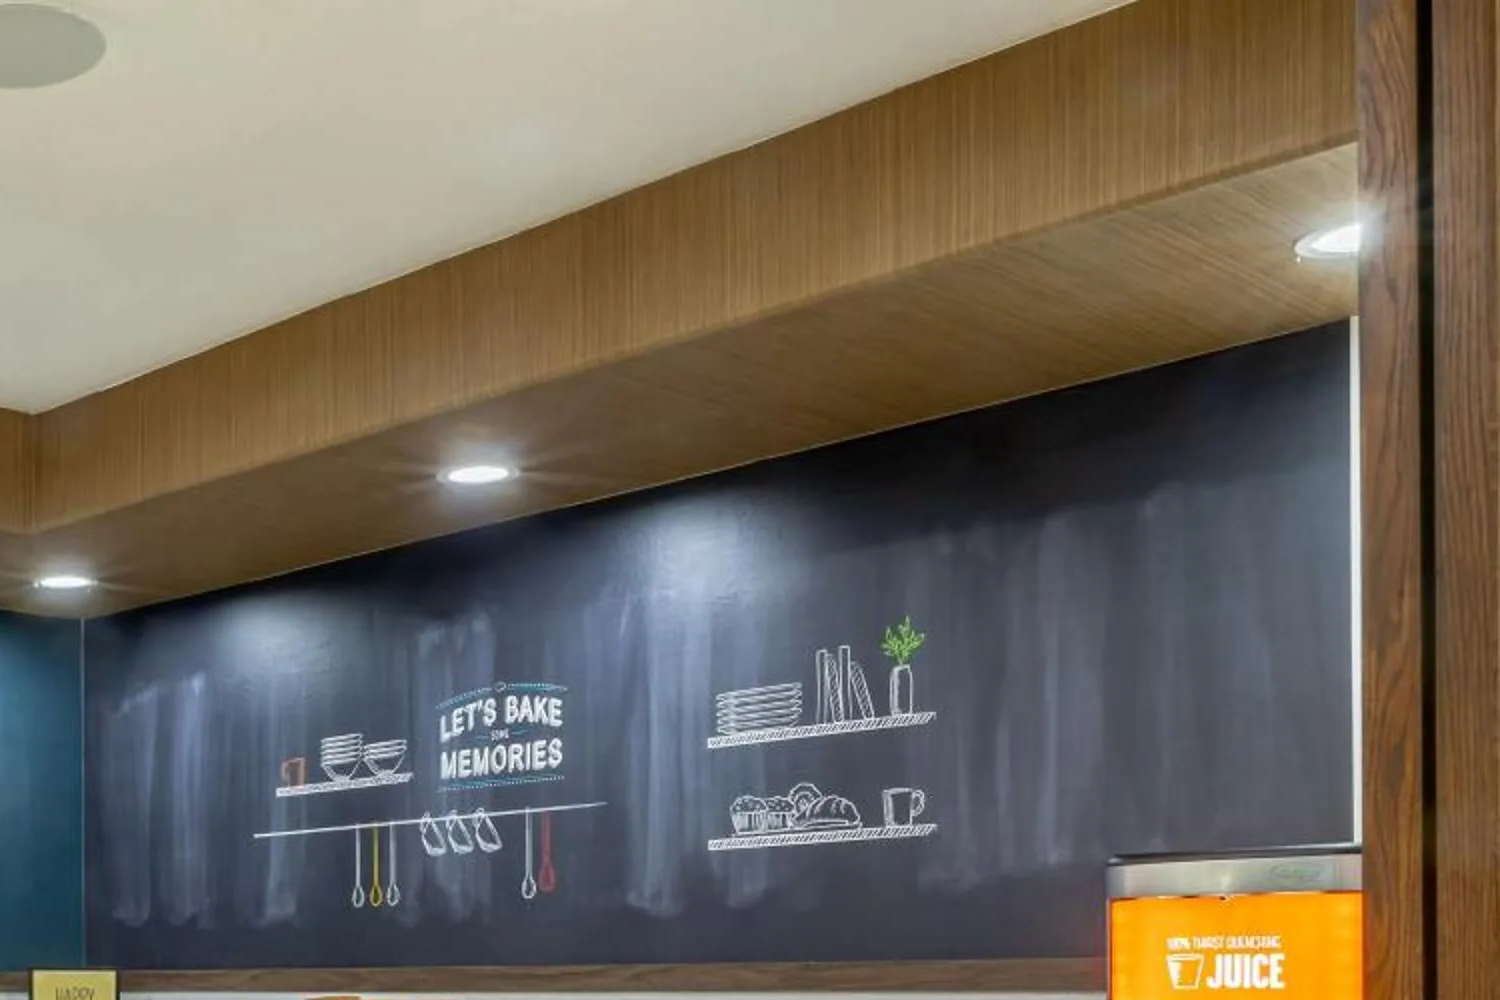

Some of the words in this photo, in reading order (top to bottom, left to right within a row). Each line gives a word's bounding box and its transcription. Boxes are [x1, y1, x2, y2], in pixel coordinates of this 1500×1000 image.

[439, 698, 497, 743] LET'S
[505, 695, 563, 727] BAKE
[440, 737, 563, 780] MEMORIES
[1206, 953, 1286, 989] JUICE
